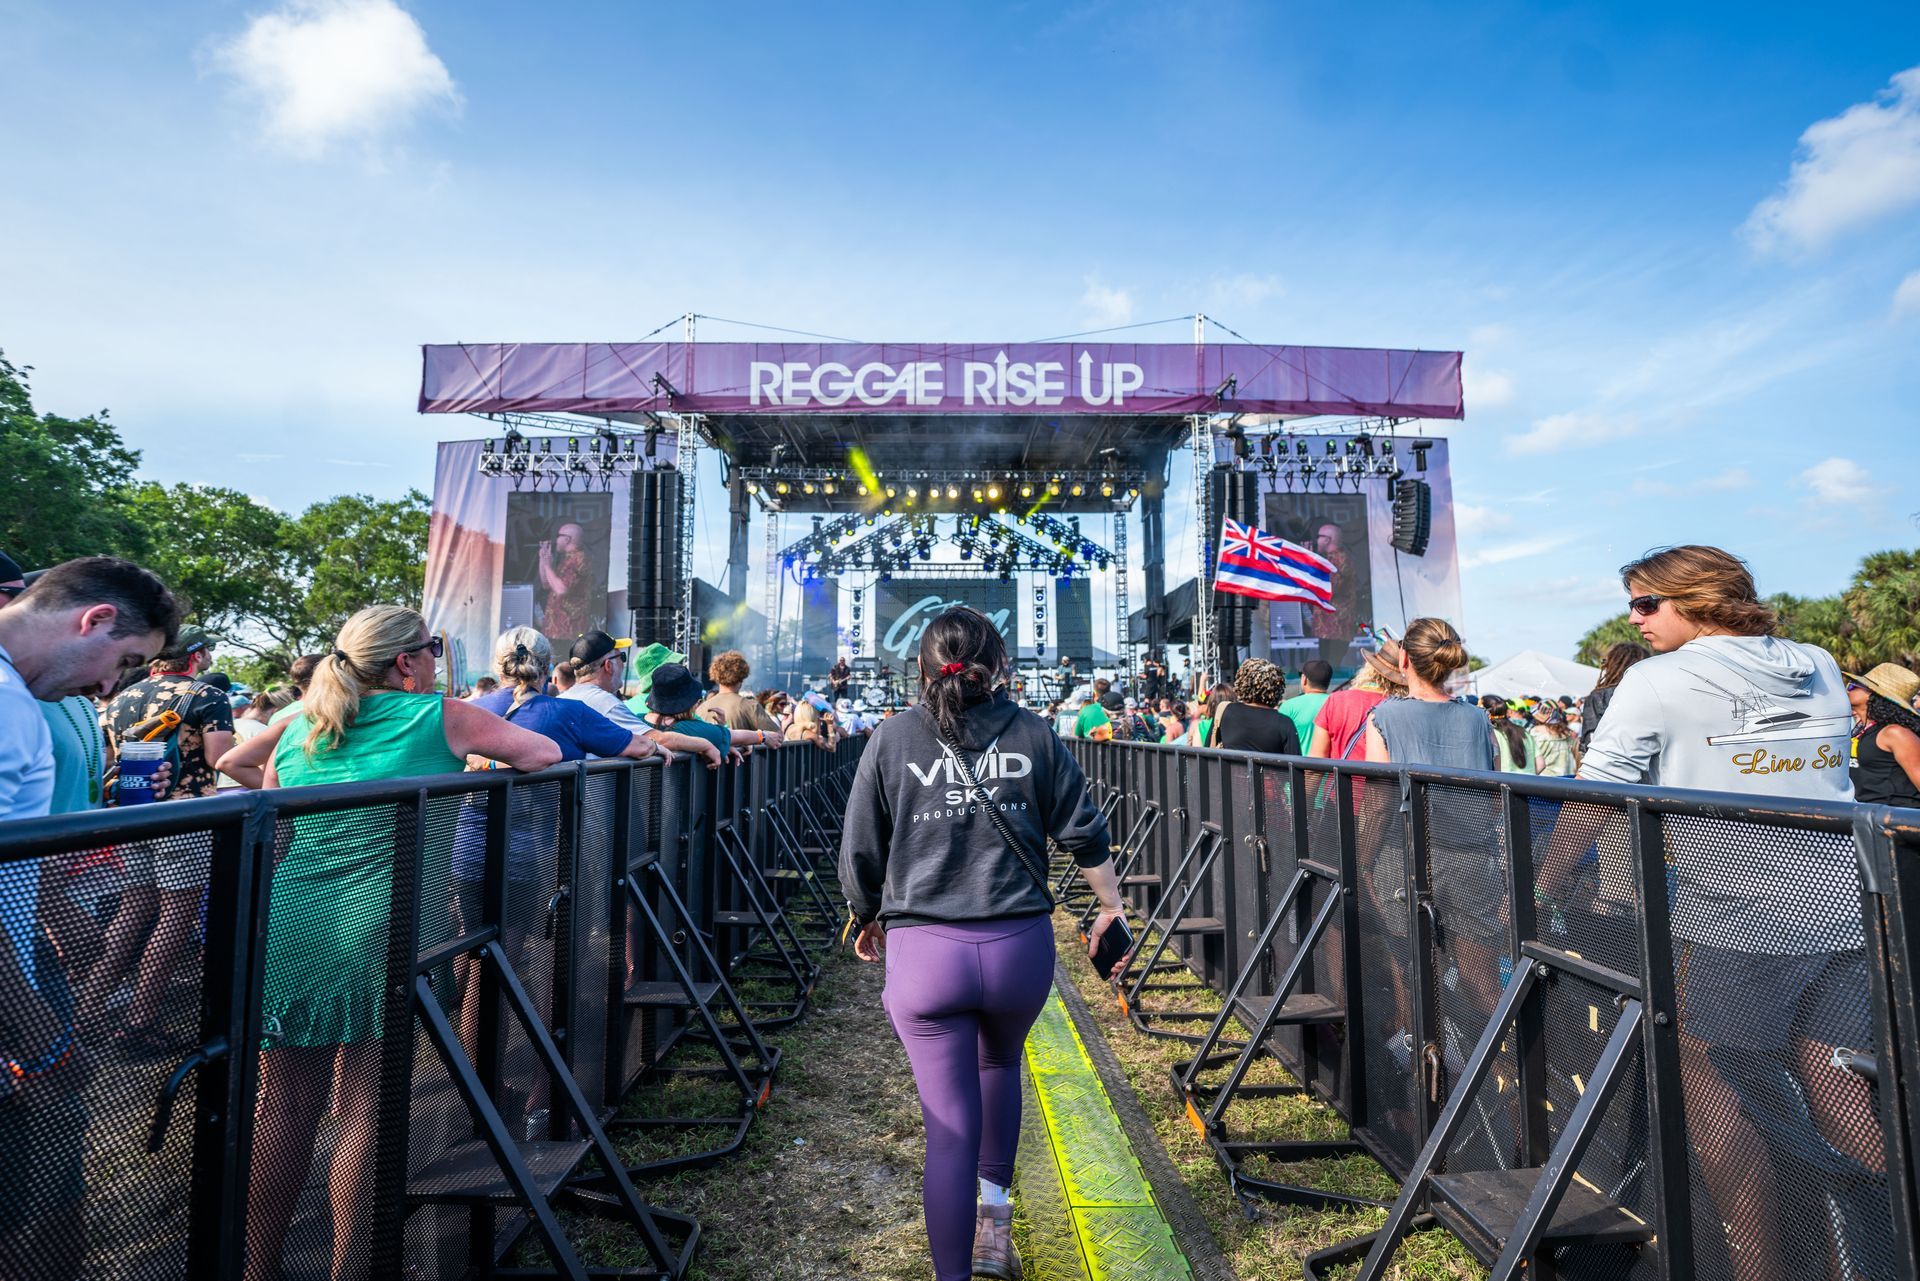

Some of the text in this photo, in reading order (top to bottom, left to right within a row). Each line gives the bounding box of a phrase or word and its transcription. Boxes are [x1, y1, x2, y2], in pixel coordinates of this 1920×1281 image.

[751, 350, 1144, 406] REGGAE RISE UP
[906, 738, 1033, 787] VIVID
[1732, 749, 1806, 775] Line
[1812, 744, 1844, 769] Set
[945, 786, 999, 805] SKY
[913, 802, 1027, 823] PRODUCTONS
